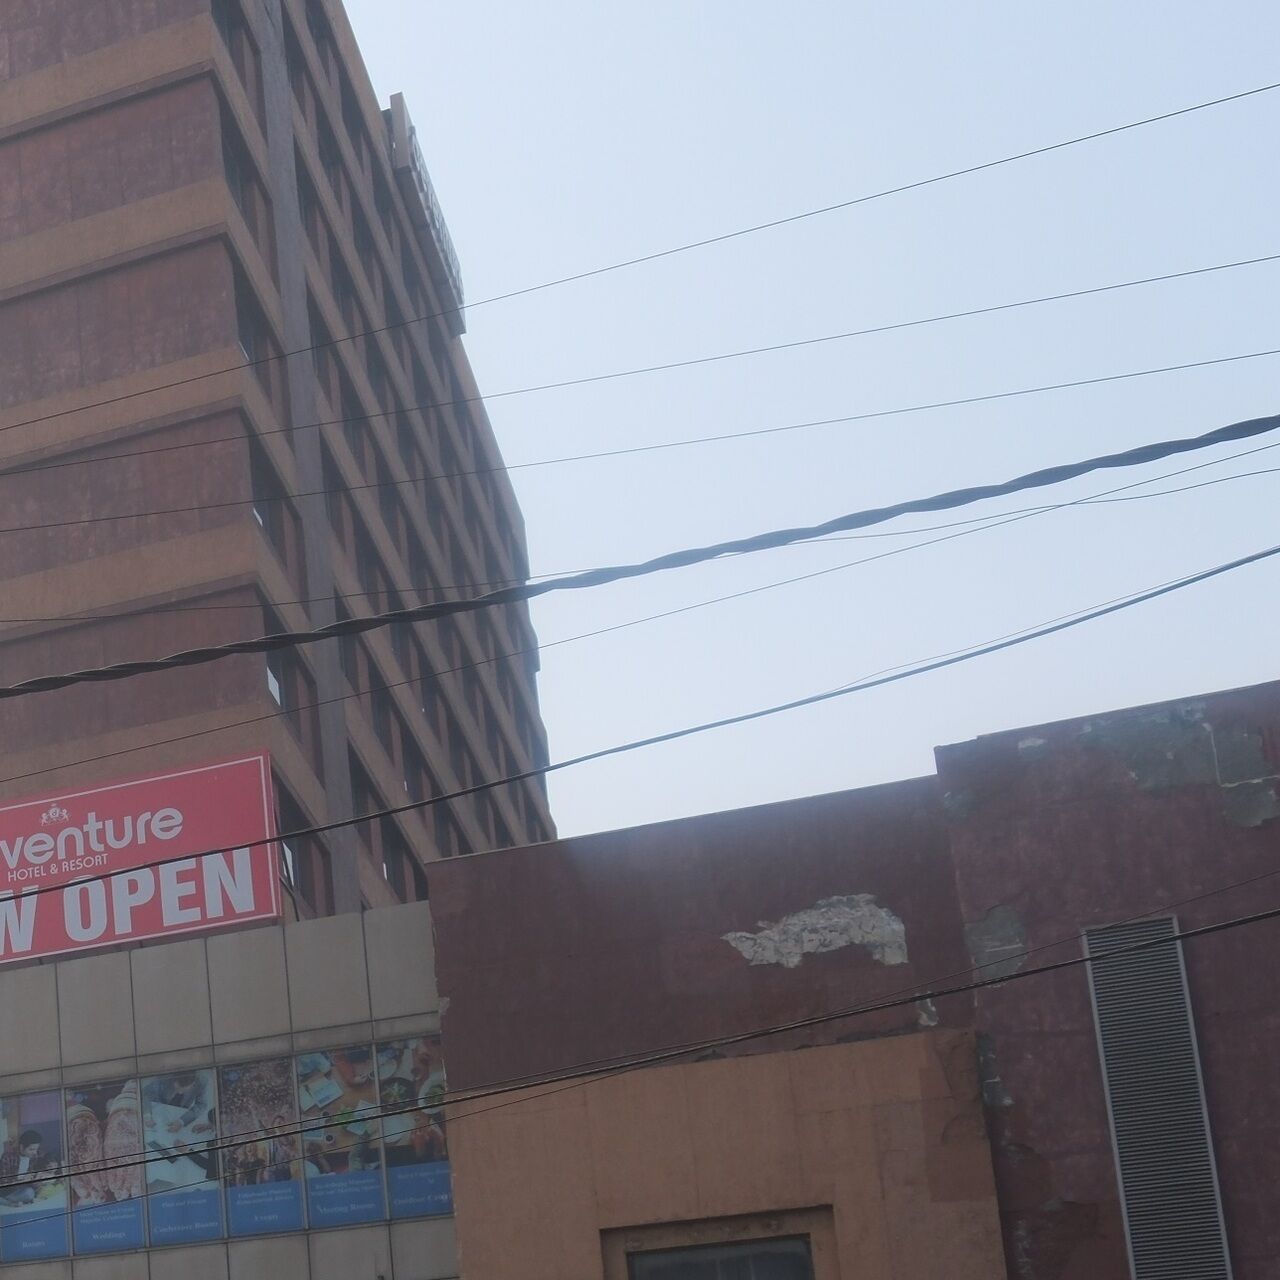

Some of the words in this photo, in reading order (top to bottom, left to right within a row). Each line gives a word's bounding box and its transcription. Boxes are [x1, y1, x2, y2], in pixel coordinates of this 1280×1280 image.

[7, 866, 46, 882] HOTEL
[50, 863, 59, 874] &
[62, 853, 108, 872] RESORT
[62, 847, 256, 942] OPEN
